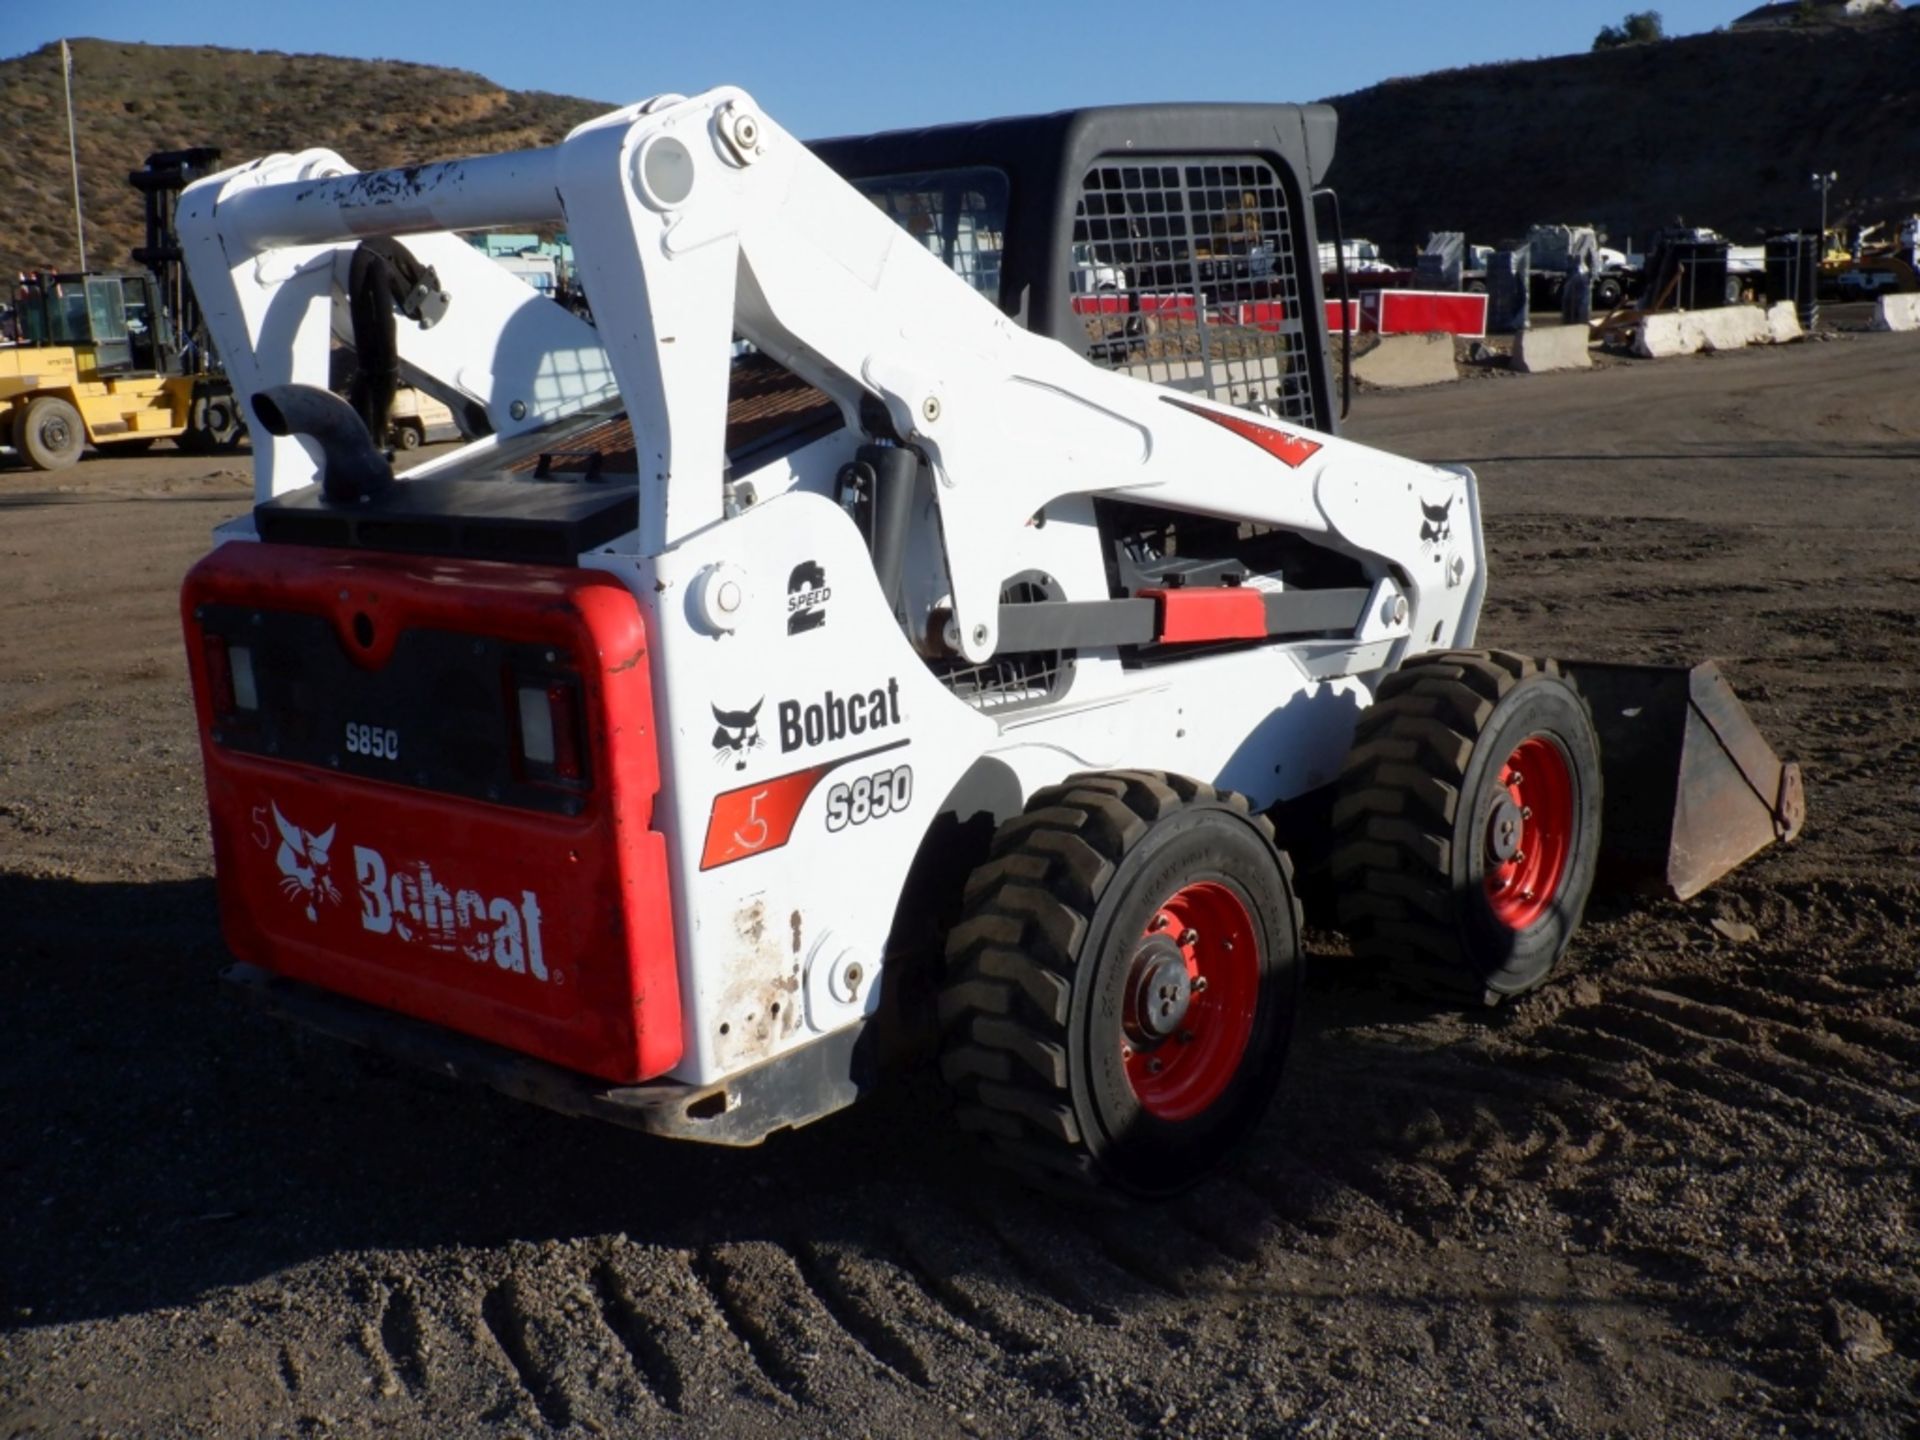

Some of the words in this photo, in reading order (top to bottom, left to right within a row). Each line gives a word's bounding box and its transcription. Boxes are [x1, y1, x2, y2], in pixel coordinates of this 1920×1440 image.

[788, 587, 831, 612] SPEED
[778, 677, 901, 753] Bobcat
[346, 722, 398, 760] S850
[734, 791, 768, 848] 5
[826, 765, 913, 833] S850
[251, 806, 271, 849] 5
